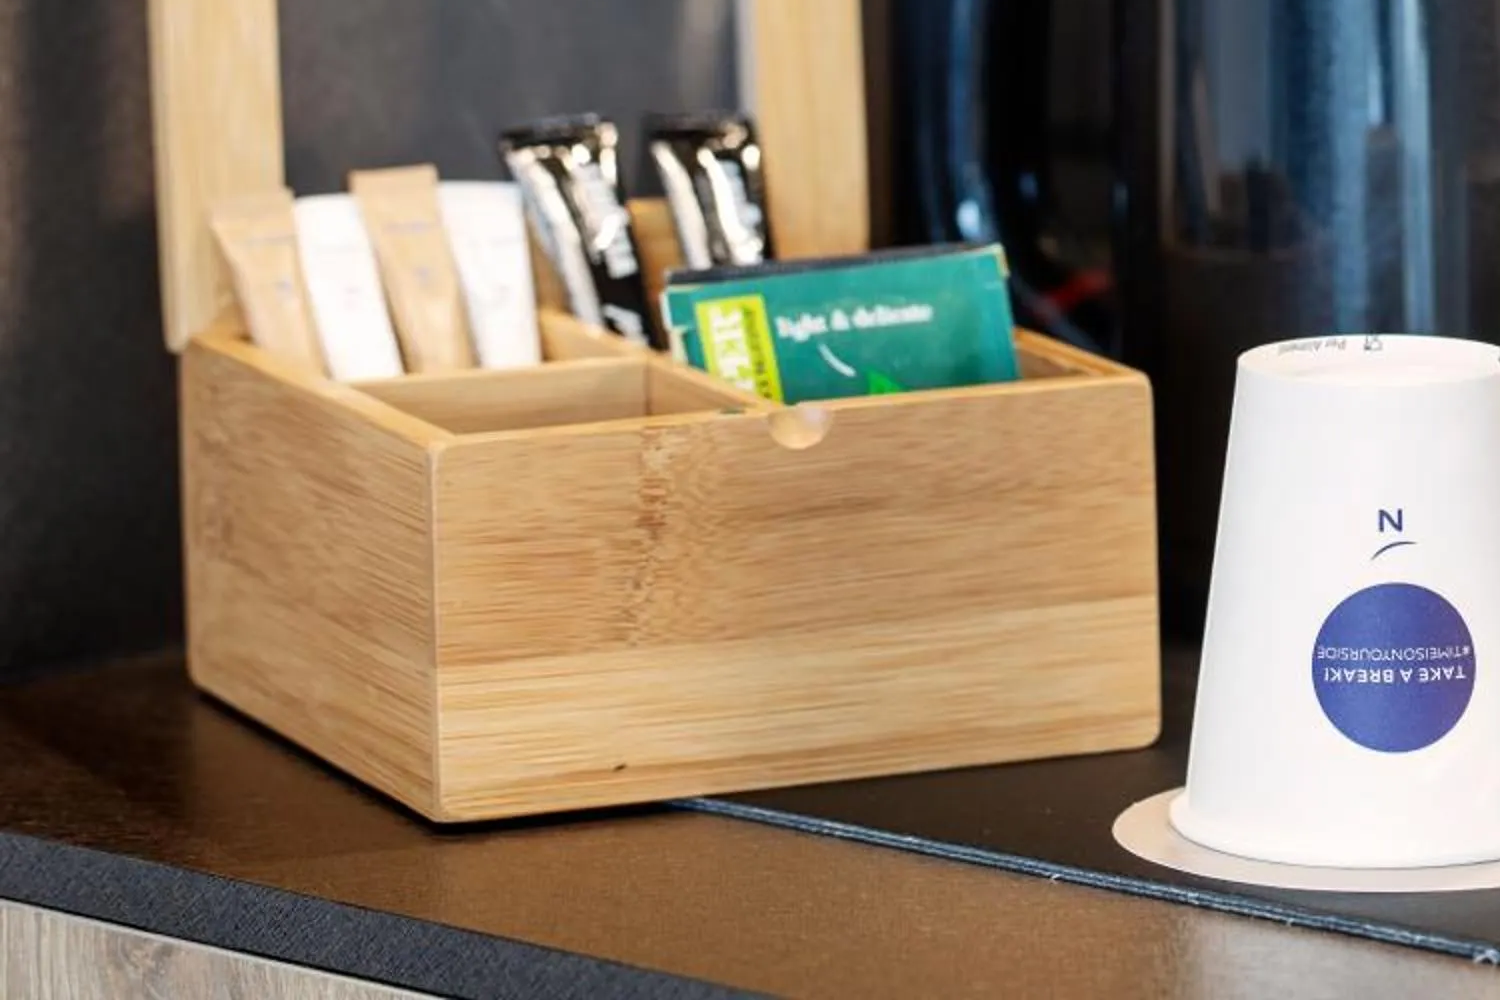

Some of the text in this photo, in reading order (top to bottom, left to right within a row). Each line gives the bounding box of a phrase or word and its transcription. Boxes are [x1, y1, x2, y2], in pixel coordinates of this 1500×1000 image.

[831, 308, 850, 331] &
[1378, 508, 1403, 532] N
[1317, 646, 1471, 660] #TIMEISONYOURSIDE
[1325, 666, 1466, 683] TAKE A BREAK!
